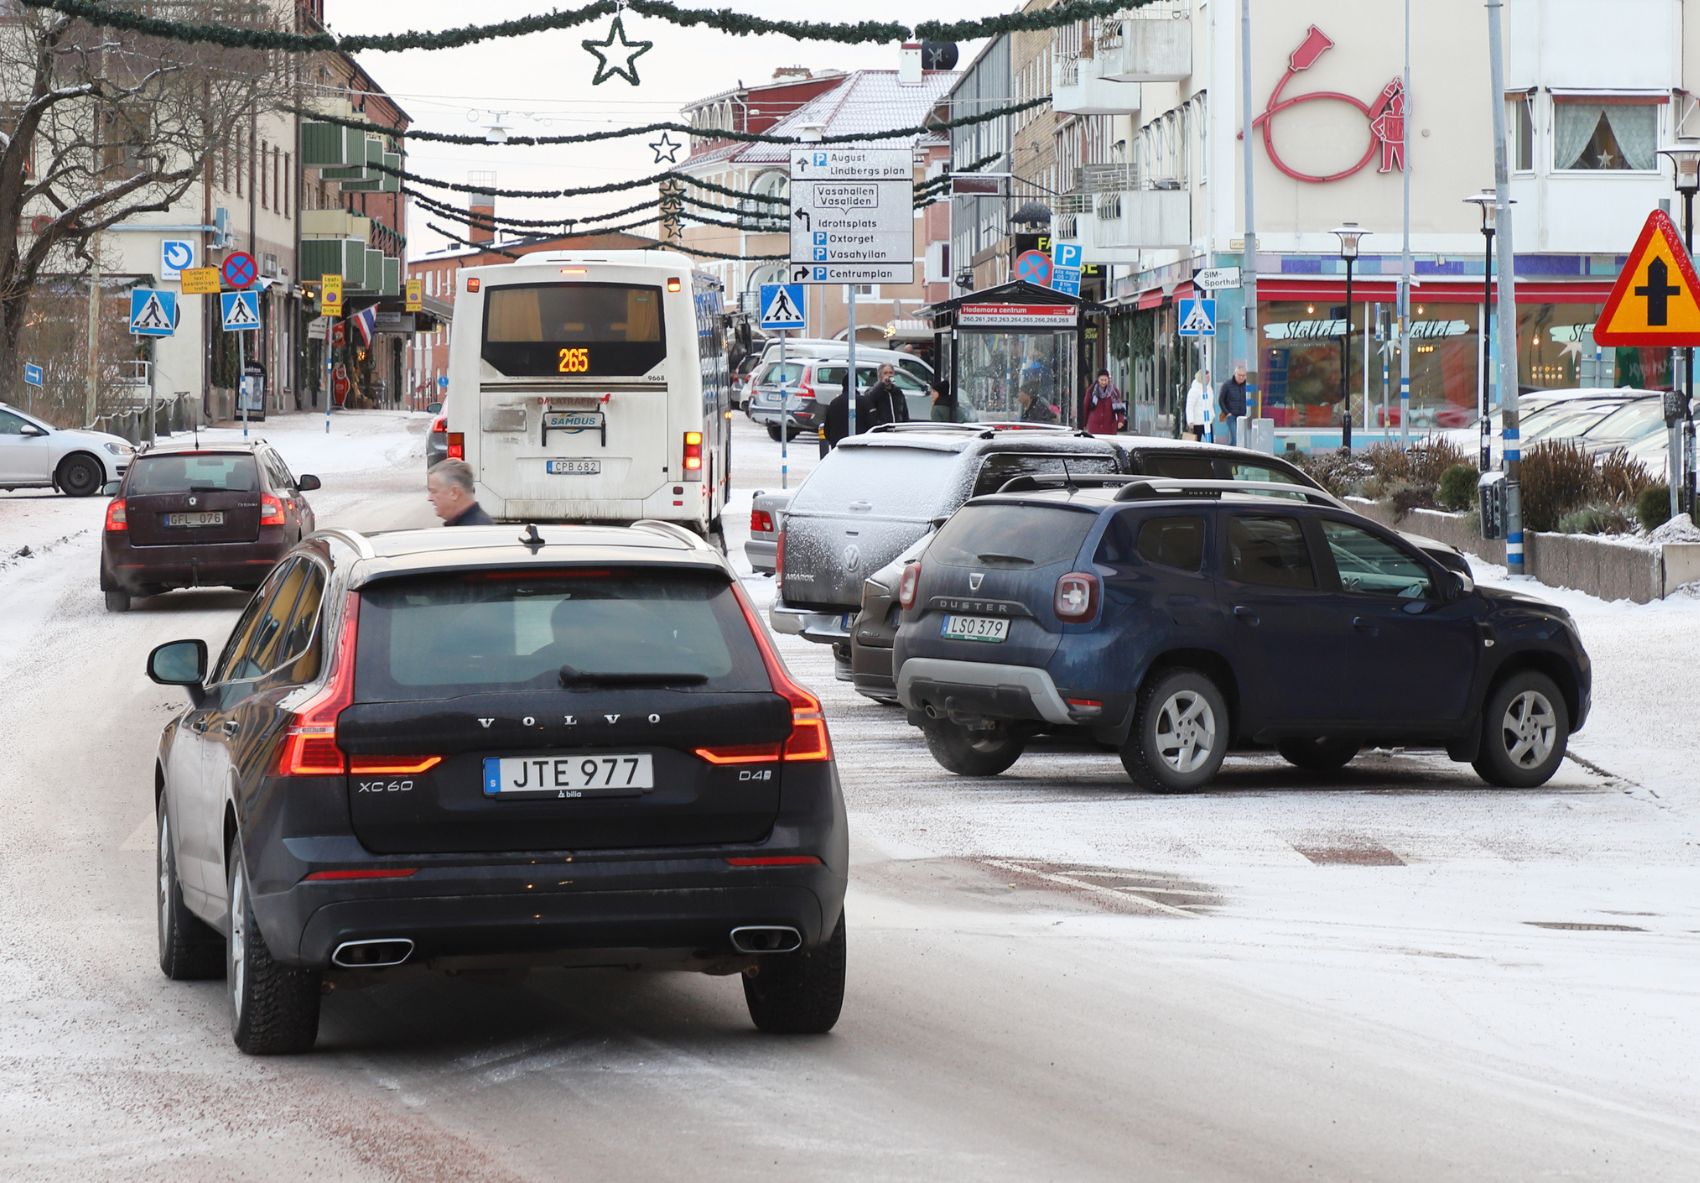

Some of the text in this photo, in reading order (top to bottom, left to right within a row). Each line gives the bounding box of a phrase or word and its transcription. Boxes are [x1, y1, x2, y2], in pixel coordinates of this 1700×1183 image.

[831, 153, 866, 163] August
[830, 166, 905, 176] Lindbergs plan
[817, 187, 875, 196] Vasahallen
[820, 196, 872, 205] Vasaliden
[818, 219, 878, 229] Idrottsplats
[829, 234, 875, 245] Oxtorget
[829, 250, 887, 260] Vasahyllan
[829, 269, 893, 279] Centrumplan
[963, 306, 998, 314] Hedemora
[1284, 319, 1337, 340] Stället
[1409, 319, 1452, 340] tället
[559, 348, 589, 373] 265
[555, 462, 596, 471] CPB 682
[170, 513, 221, 525] GFL 076
[940, 600, 1008, 612] DUSTER
[951, 617, 1003, 636] LSO 379
[477, 713, 661, 728] VOLVO
[513, 759, 570, 788] JTE
[580, 757, 640, 786] 977
